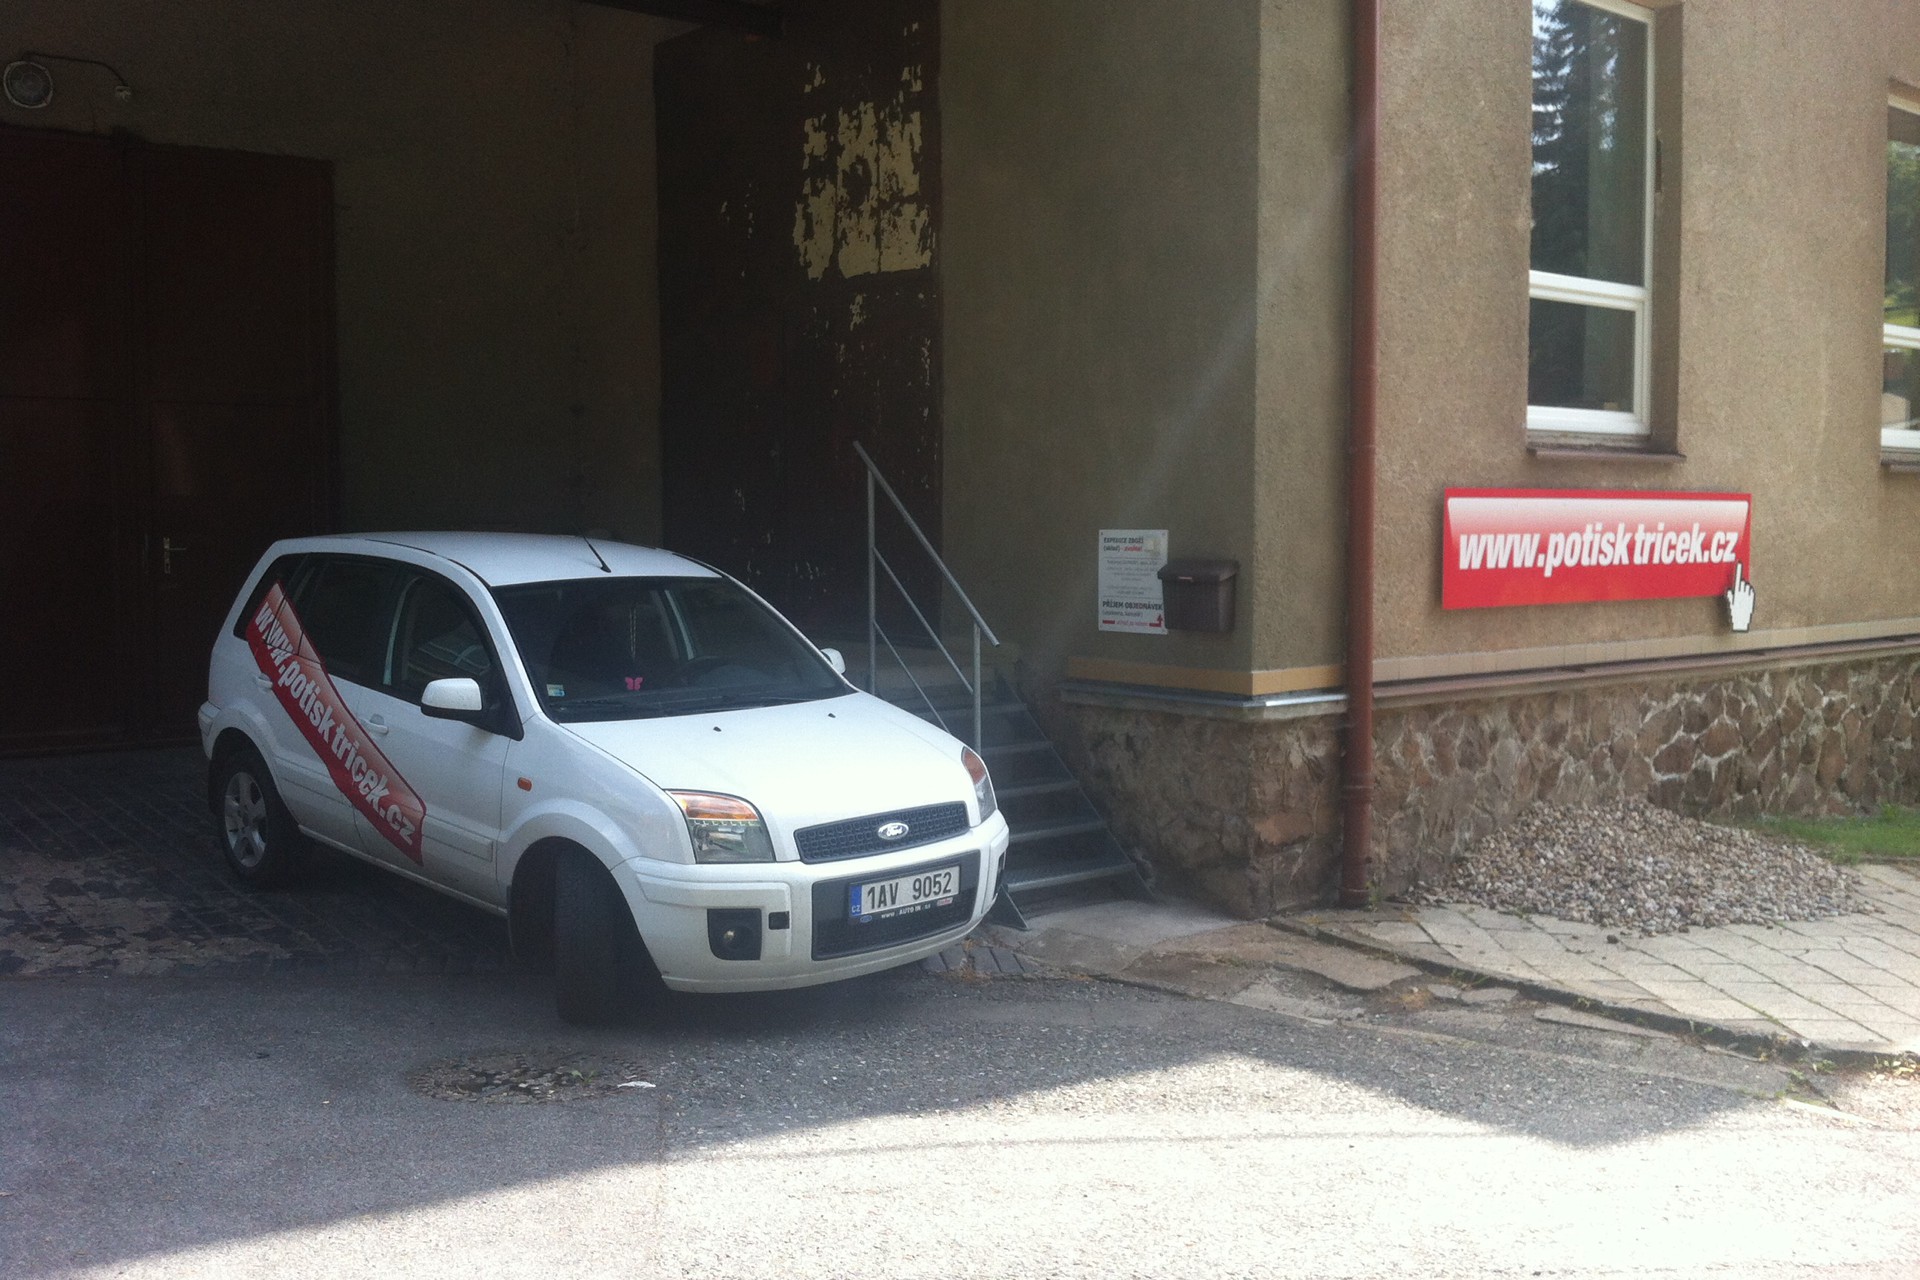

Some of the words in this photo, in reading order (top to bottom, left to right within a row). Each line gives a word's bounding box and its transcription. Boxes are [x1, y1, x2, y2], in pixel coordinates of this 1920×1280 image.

[1102, 599, 1124, 609] PŘÍJEM
[867, 882, 899, 910] 1AV
[912, 872, 952, 900] 9052
[851, 904, 861, 913] CZ
